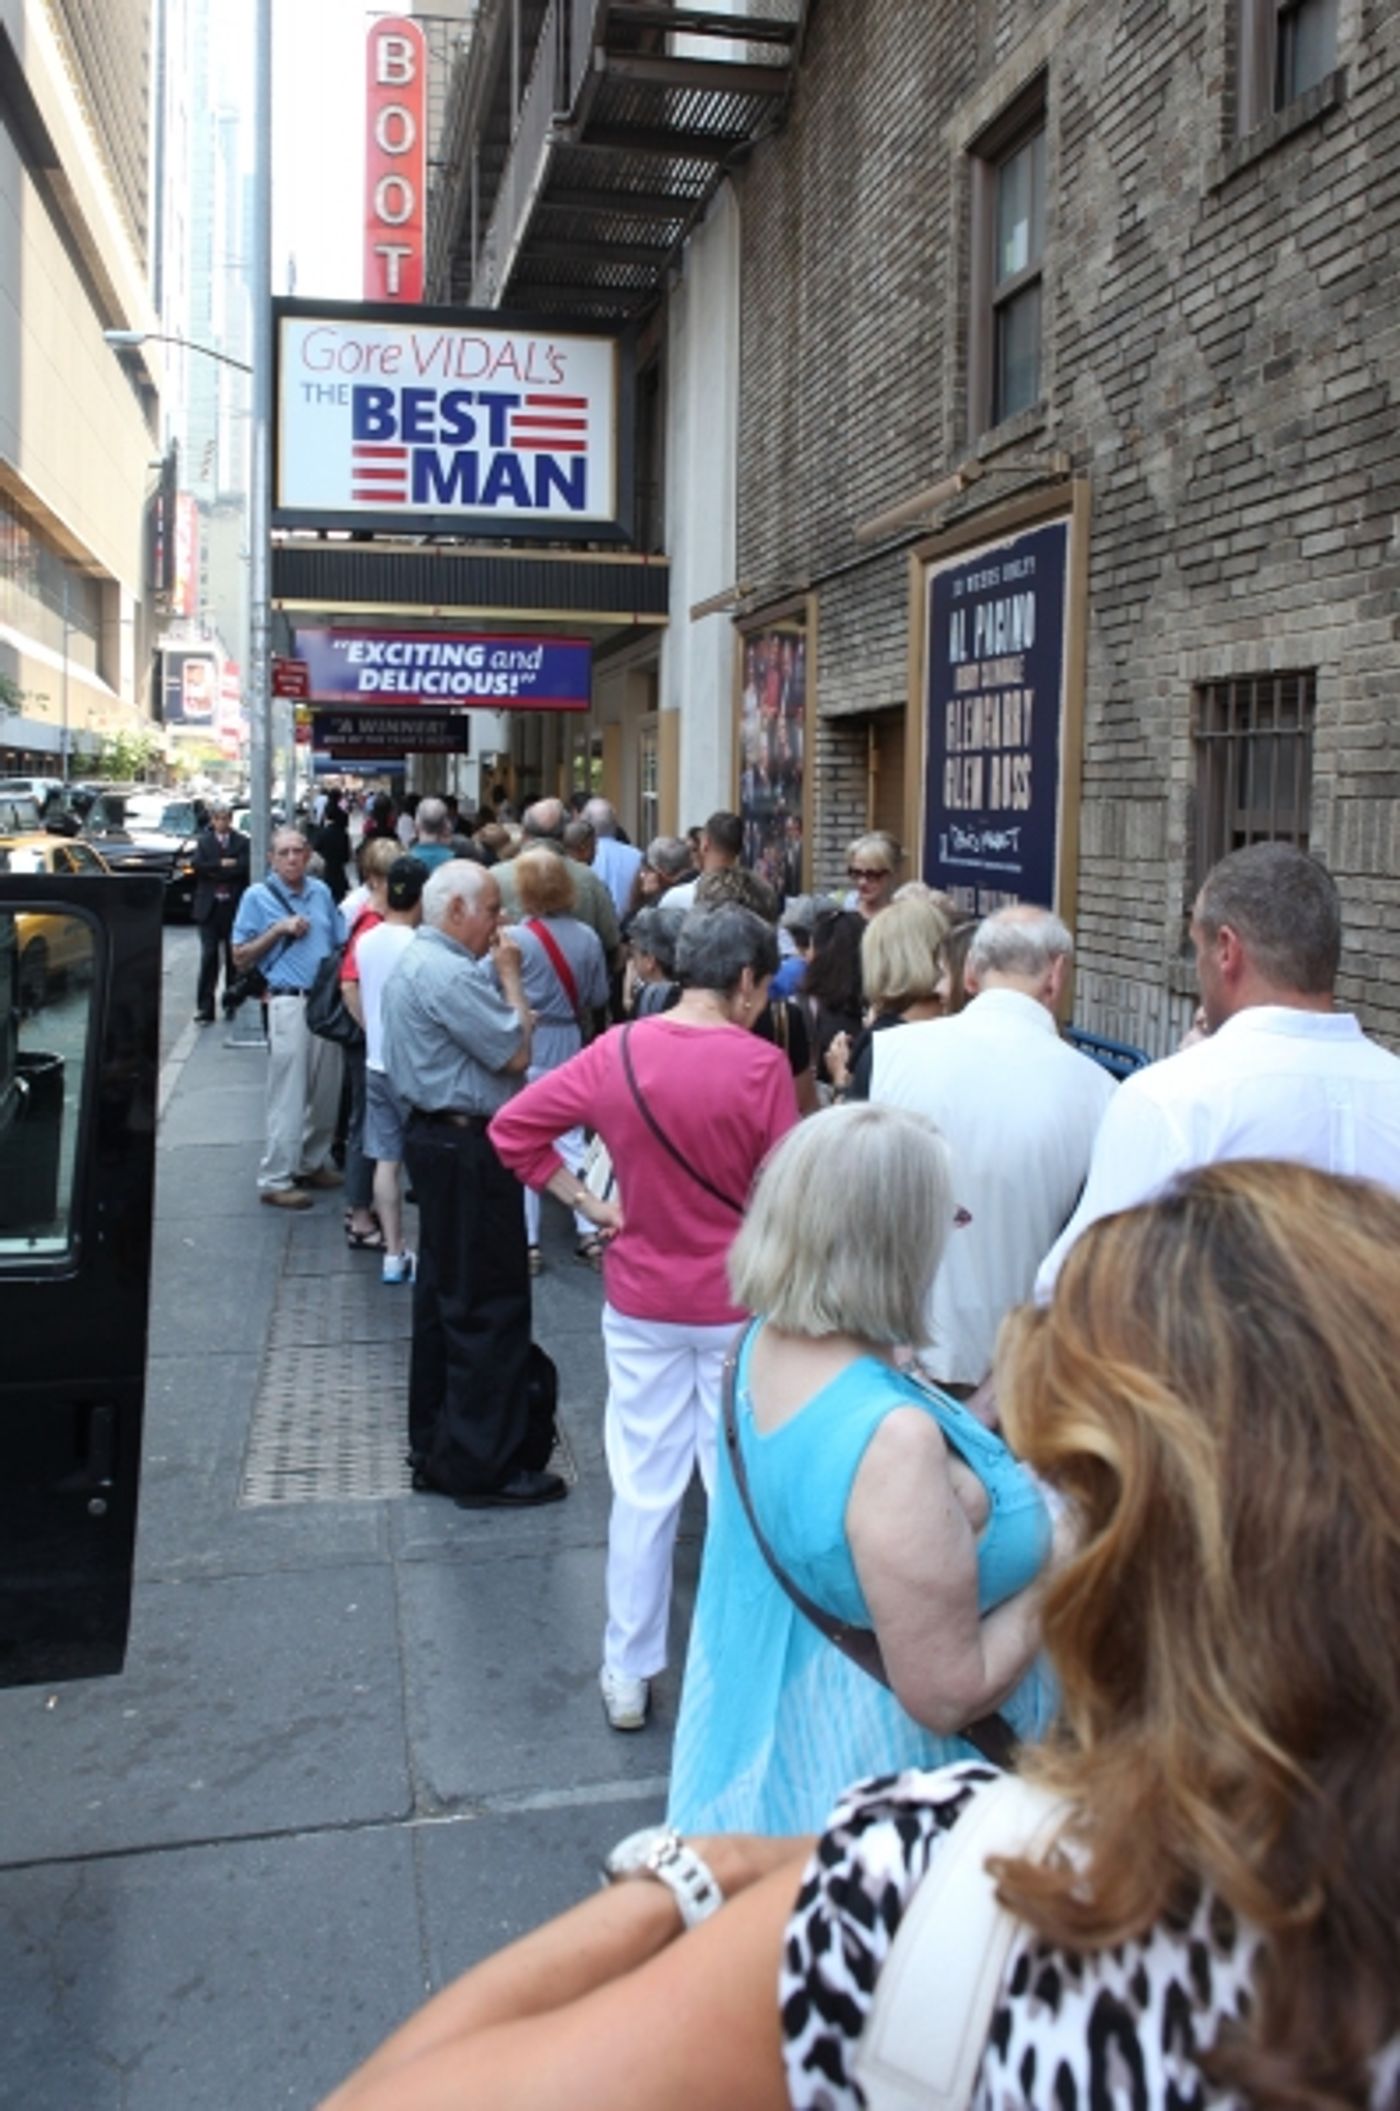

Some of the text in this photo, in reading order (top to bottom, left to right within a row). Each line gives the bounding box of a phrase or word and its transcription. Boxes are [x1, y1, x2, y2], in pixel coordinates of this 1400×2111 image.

[374, 34, 416, 295] BOOT
[301, 328, 566, 385] Gore VIDAL's
[301, 381, 521, 447] THE BEST
[412, 448, 586, 510] MAN
[334, 640, 543, 670] "EXCITING and
[949, 591, 1035, 663] AL PACINO
[358, 668, 536, 696] DELICIOUS!"
[944, 753, 1032, 810] GLEN ROSS
